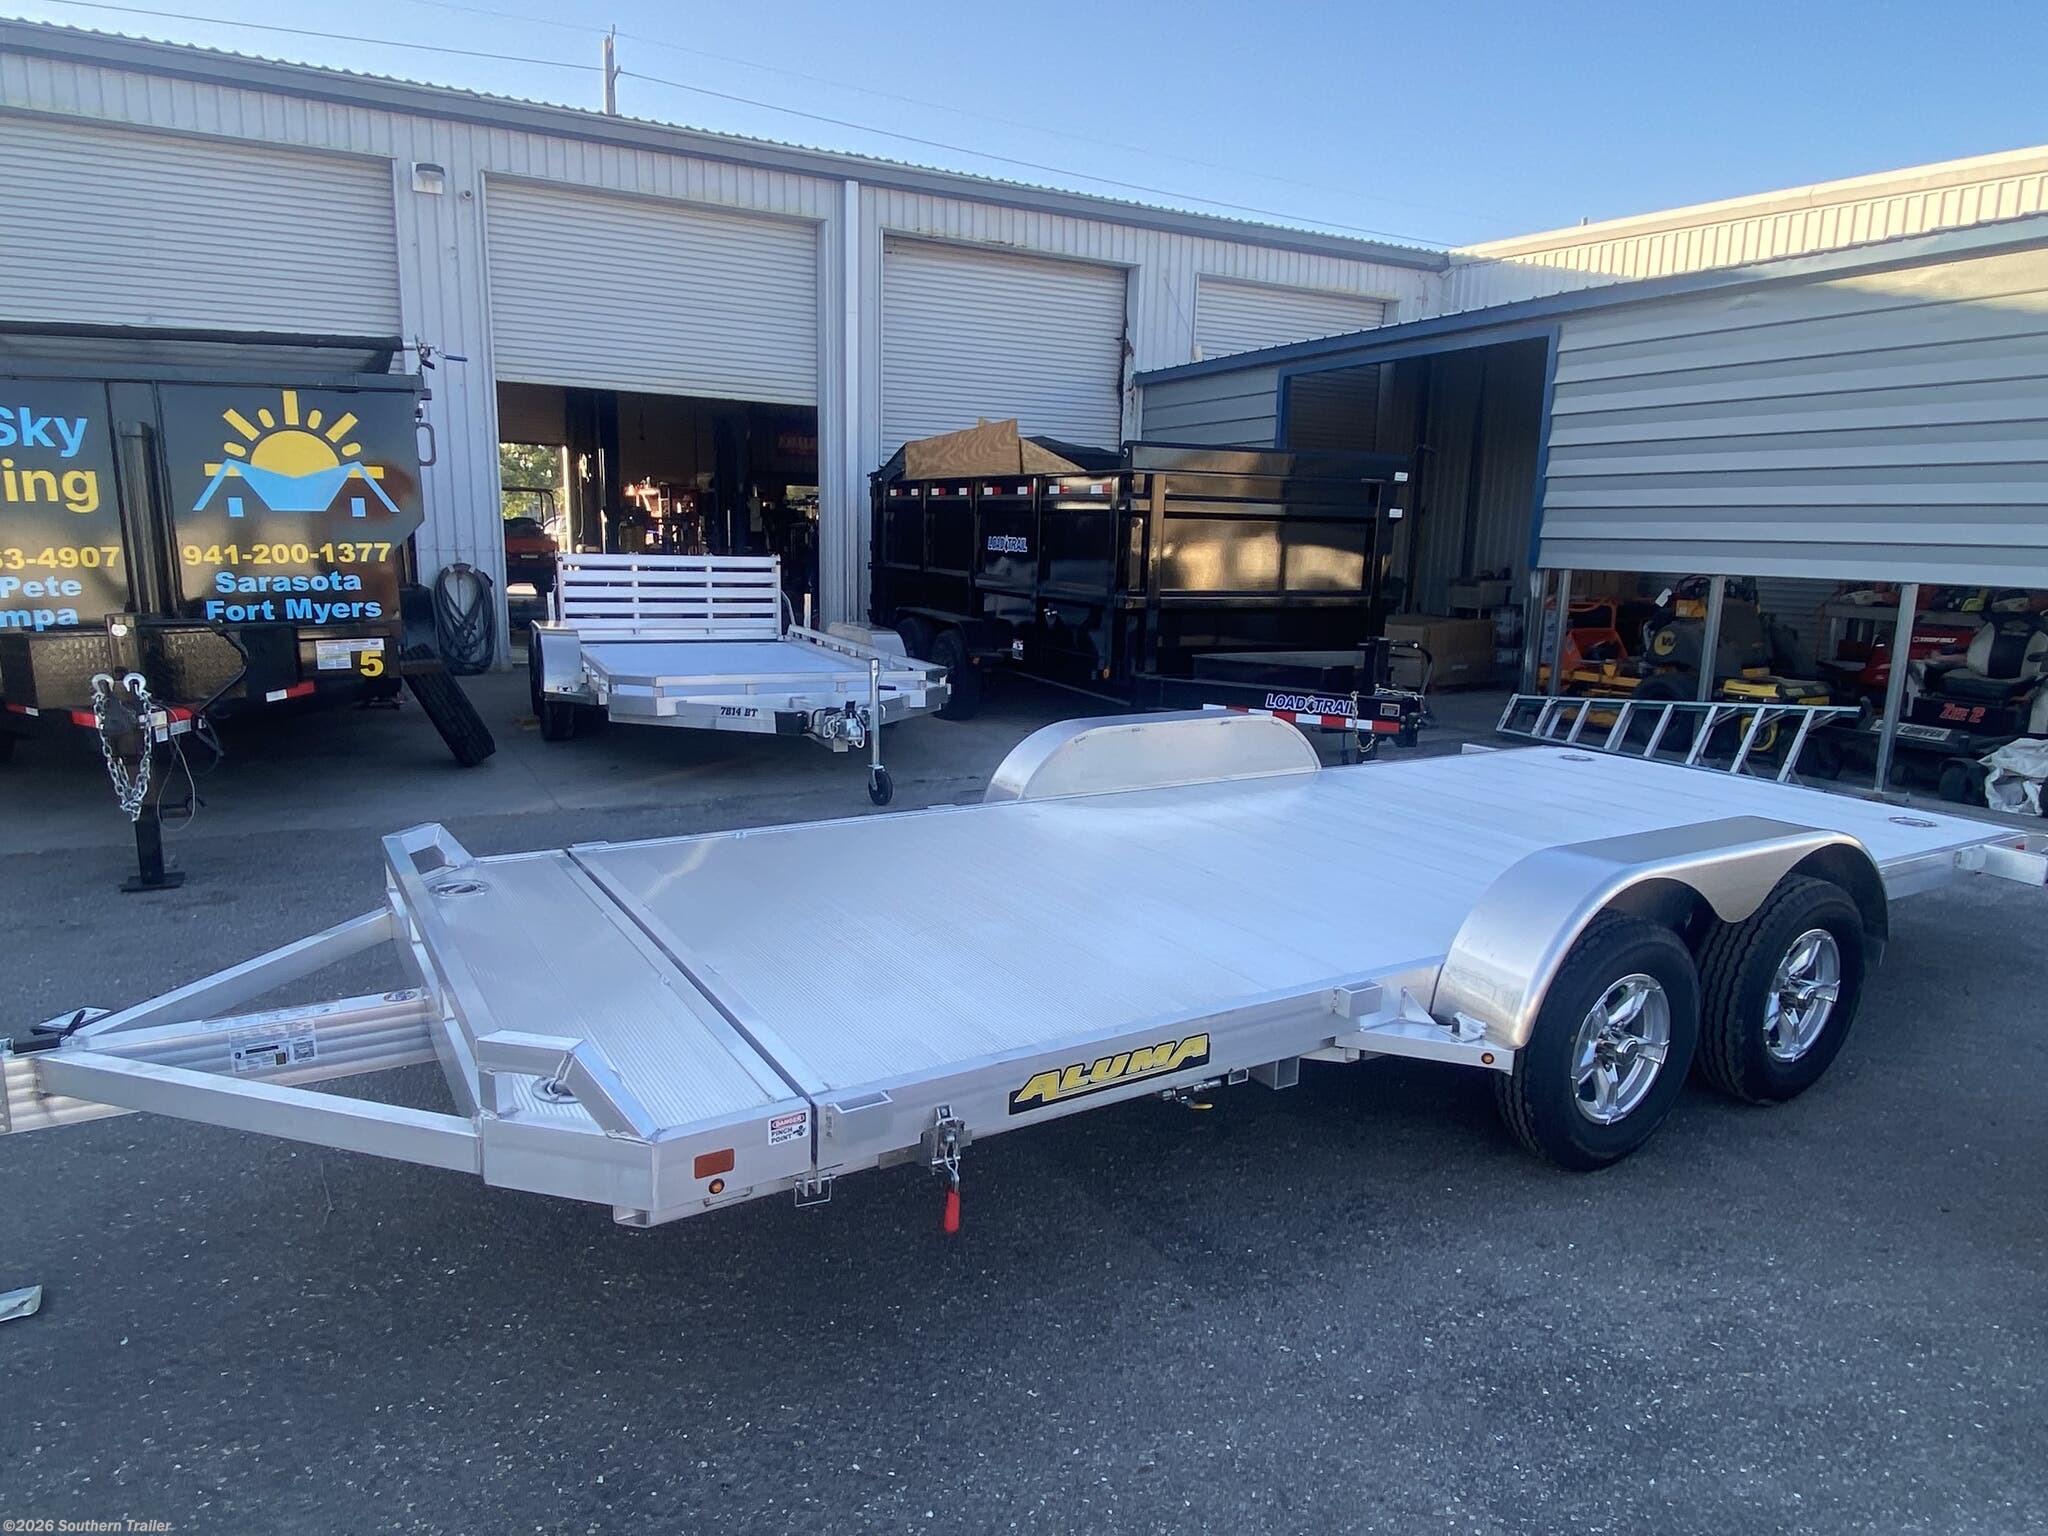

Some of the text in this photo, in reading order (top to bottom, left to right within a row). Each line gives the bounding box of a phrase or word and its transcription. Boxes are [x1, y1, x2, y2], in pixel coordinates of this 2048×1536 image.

[0, 546, 120, 570] 3-4907
[182, 543, 392, 566] 941-200-1377
[0, 575, 82, 598] Pete
[214, 570, 362, 593] Sarasota
[205, 598, 383, 624] Fort Myers
[360, 650, 385, 677] 5
[720, 706, 742, 717] 7814
[1265, 693, 1306, 711] LOAD
[1013, 1033, 1209, 1103] ALUMA
[771, 1126, 793, 1137] PINCH
[771, 1133, 792, 1144] POINT
